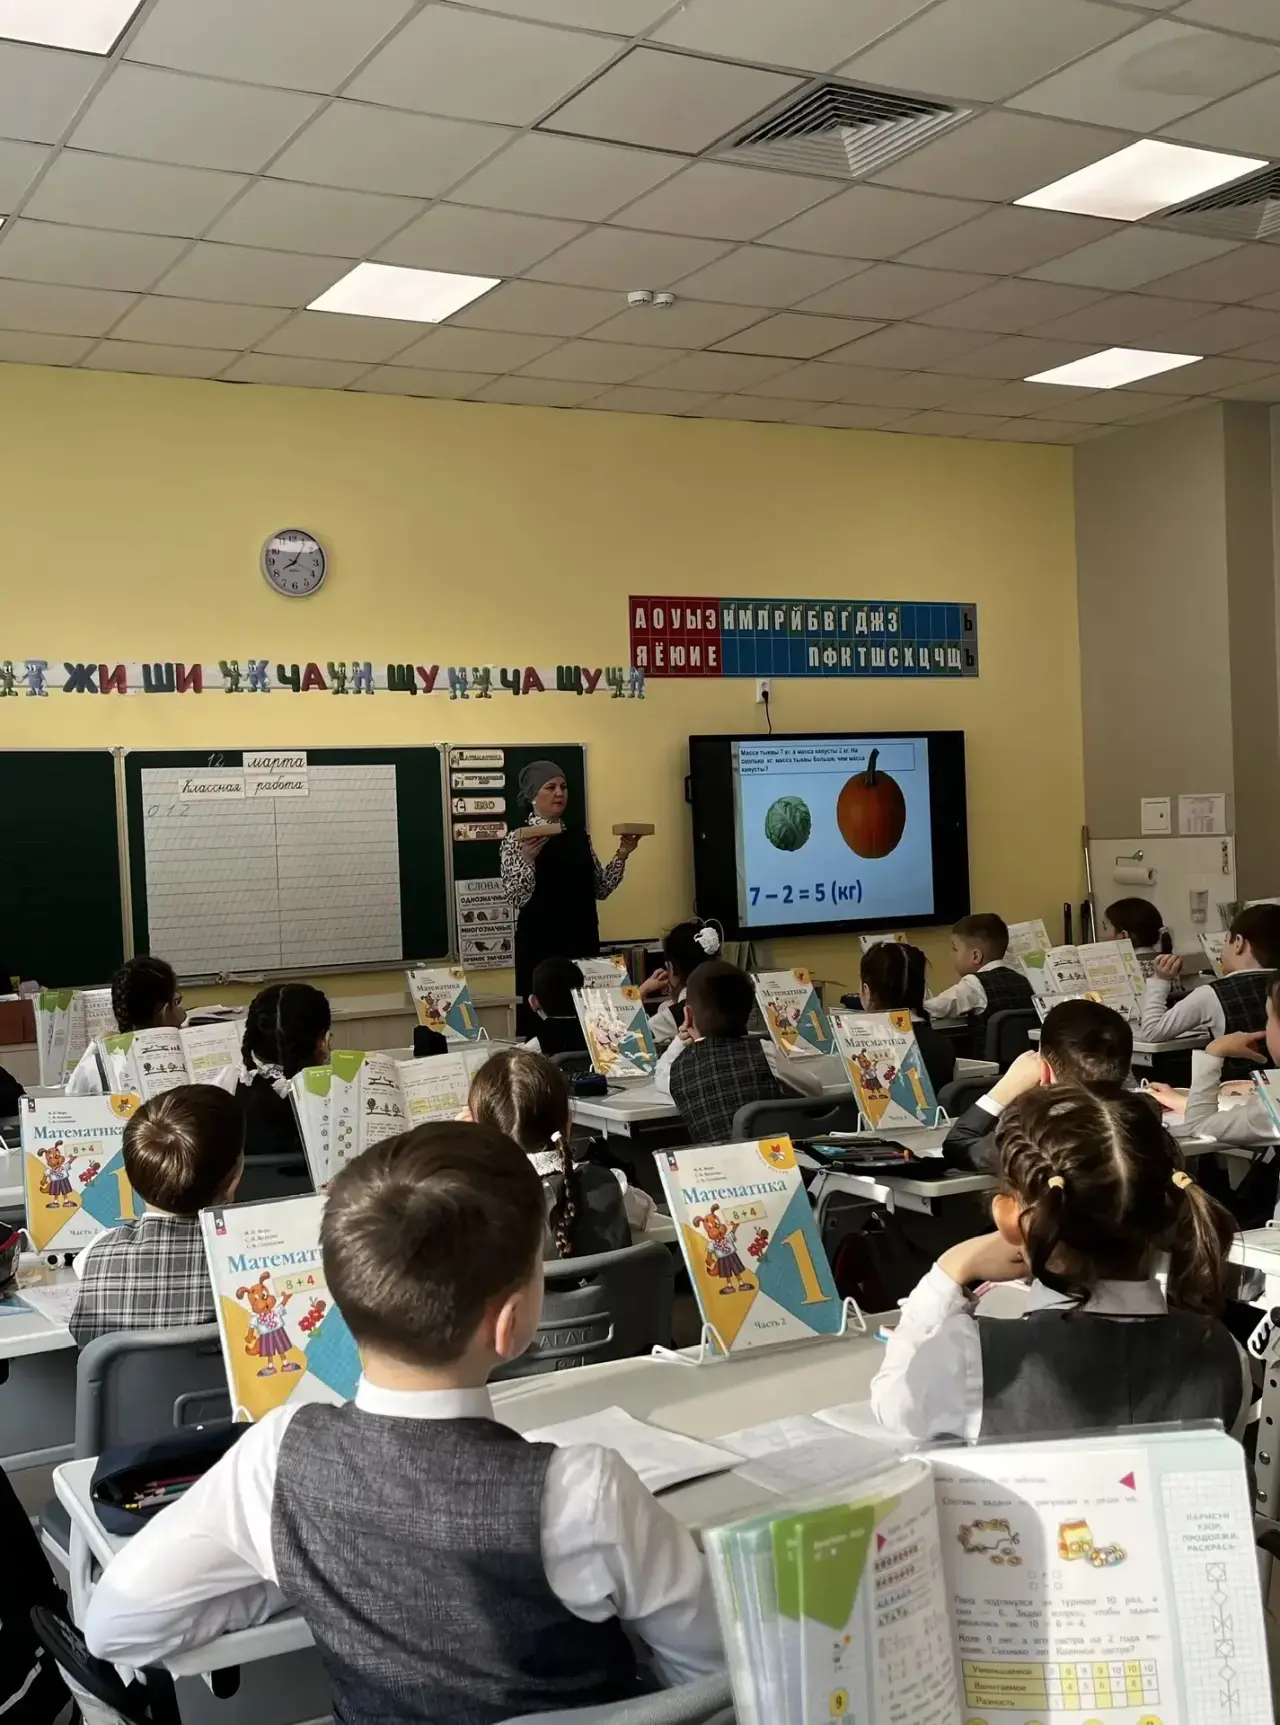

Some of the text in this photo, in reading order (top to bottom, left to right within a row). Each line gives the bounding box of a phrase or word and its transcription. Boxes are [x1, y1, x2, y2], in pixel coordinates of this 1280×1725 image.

[268, 558, 276, 566] 9
[312, 559, 320, 568] 3
[310, 570, 316, 578] 4
[280, 578, 288, 588] 7
[292, 581, 299, 590] 6
[304, 578, 310, 587] 5
[63, 661, 128, 695] ЖИ
[142, 661, 203, 694] ШИ
[276, 662, 330, 693] ЧА
[386, 663, 440, 696] ЩУ
[500, 666, 546, 696] ЧА
[555, 664, 603, 697] ЩУ
[207, 753, 225, 768] 12
[247, 756, 305, 774] марта
[182, 775, 303, 796] Классная работа
[467, 881, 500, 892] СЛОВА
[750, 887, 760, 906] 7
[782, 885, 794, 904] 2
[815, 883, 826, 902] 5
[832, 879, 862, 906] (кг)
[416, 983, 460, 992] Математика
[762, 988, 808, 997] Математика
[456, 1003, 473, 1030] 1
[808, 1010, 828, 1042] 1
[844, 1036, 907, 1048] Математика
[904, 1067, 932, 1110] 1
[88, 1144, 95, 1152] 4
[108, 1166, 138, 1222] 1
[681, 1178, 788, 1205] Математика
[732, 1210, 739, 1220] 8
[750, 1207, 757, 1216] 4
[227, 1248, 323, 1274] Математ
[780, 1228, 832, 1305] 1
[285, 1280, 294, 1290] 8
[306, 1274, 316, 1286] 4
[754, 1318, 787, 1330] Часть 2
[1128, 1665, 1137, 1674] 10
